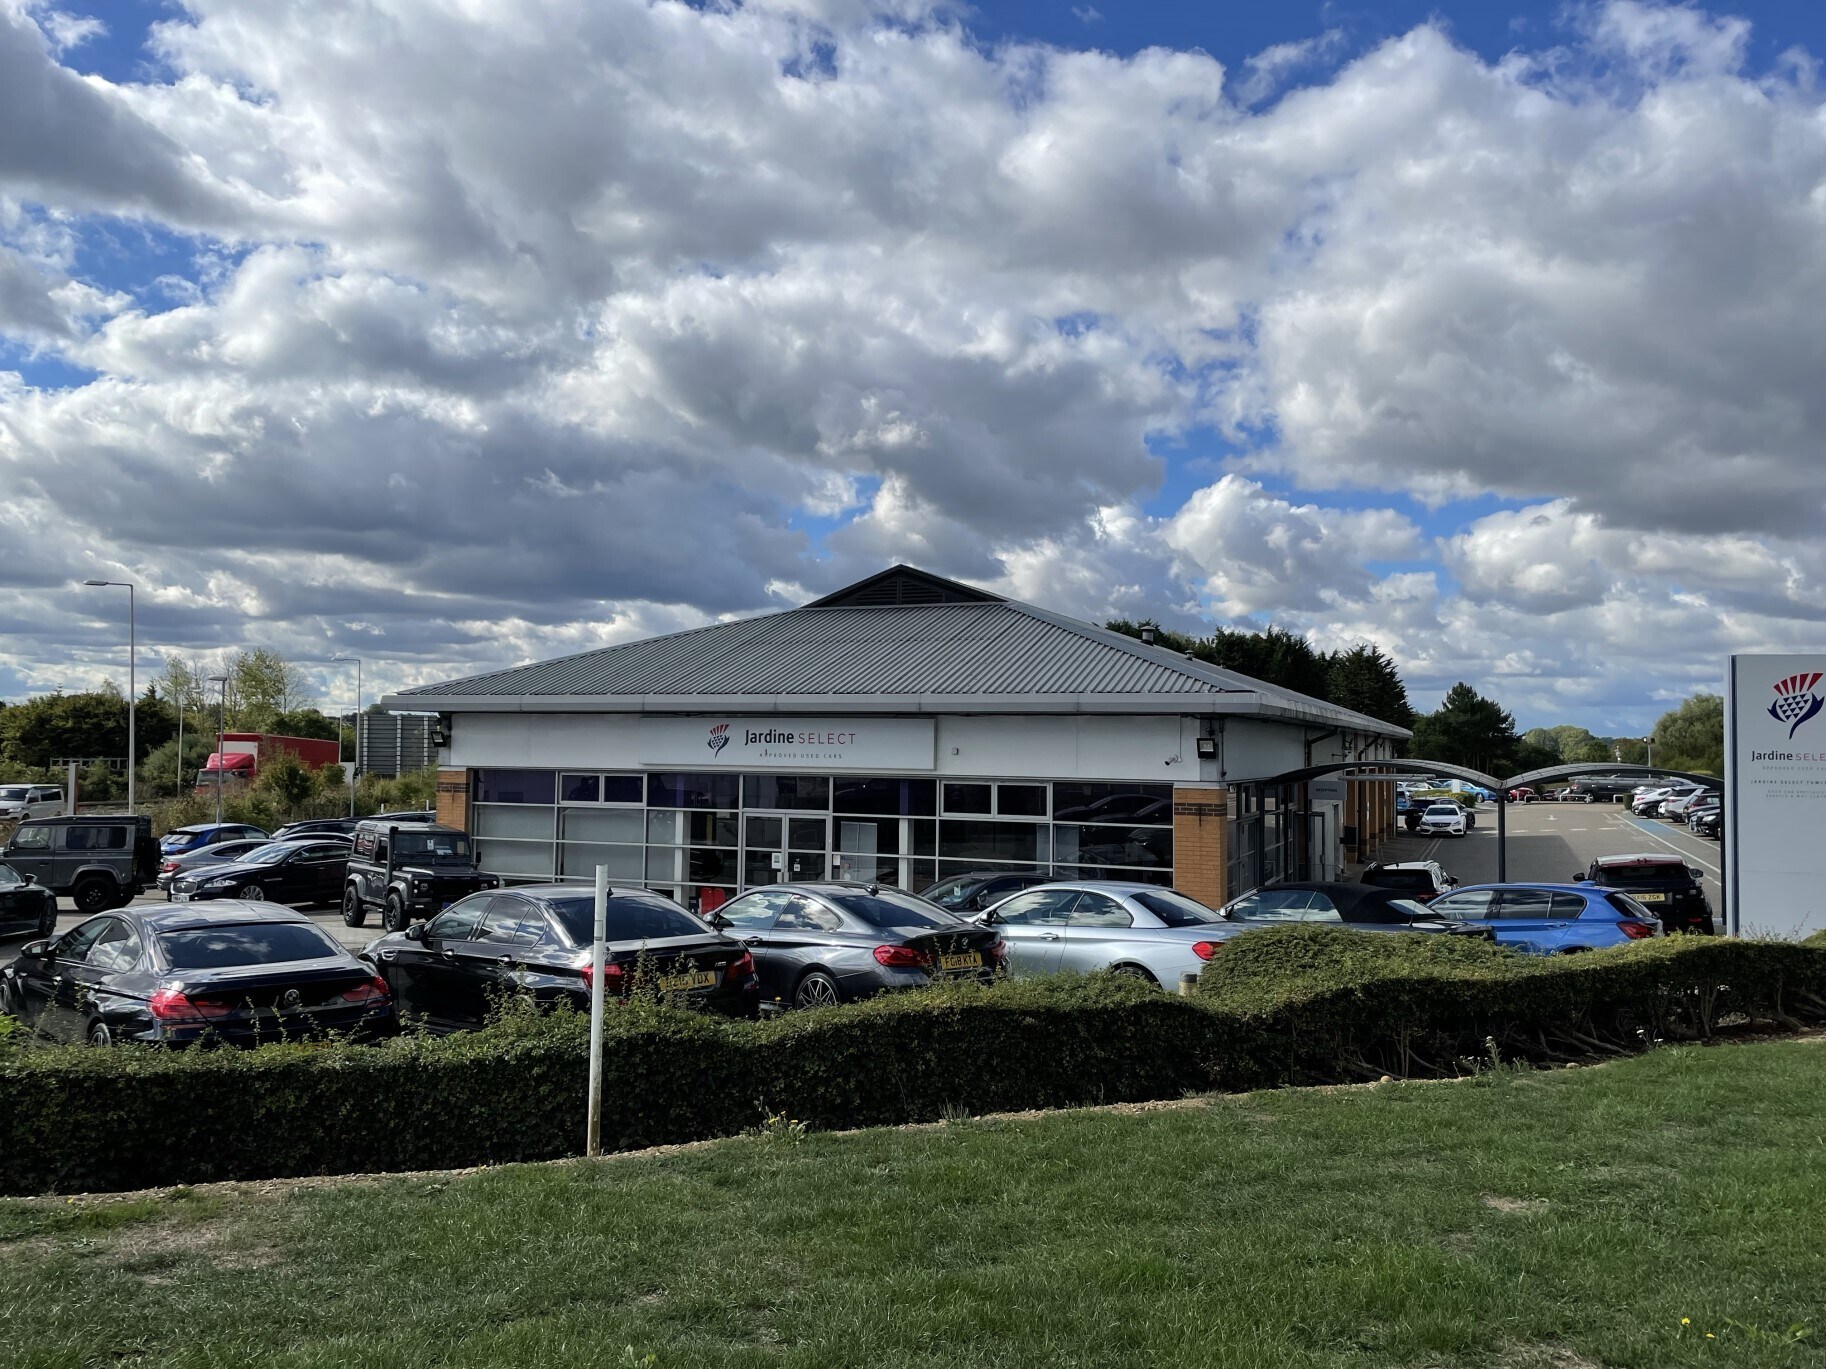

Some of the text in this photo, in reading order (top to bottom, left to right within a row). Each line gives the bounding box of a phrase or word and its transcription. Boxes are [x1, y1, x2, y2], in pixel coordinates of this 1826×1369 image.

[744, 728, 856, 746] Jardine SELECT
[1751, 750, 1793, 762] Jardine
